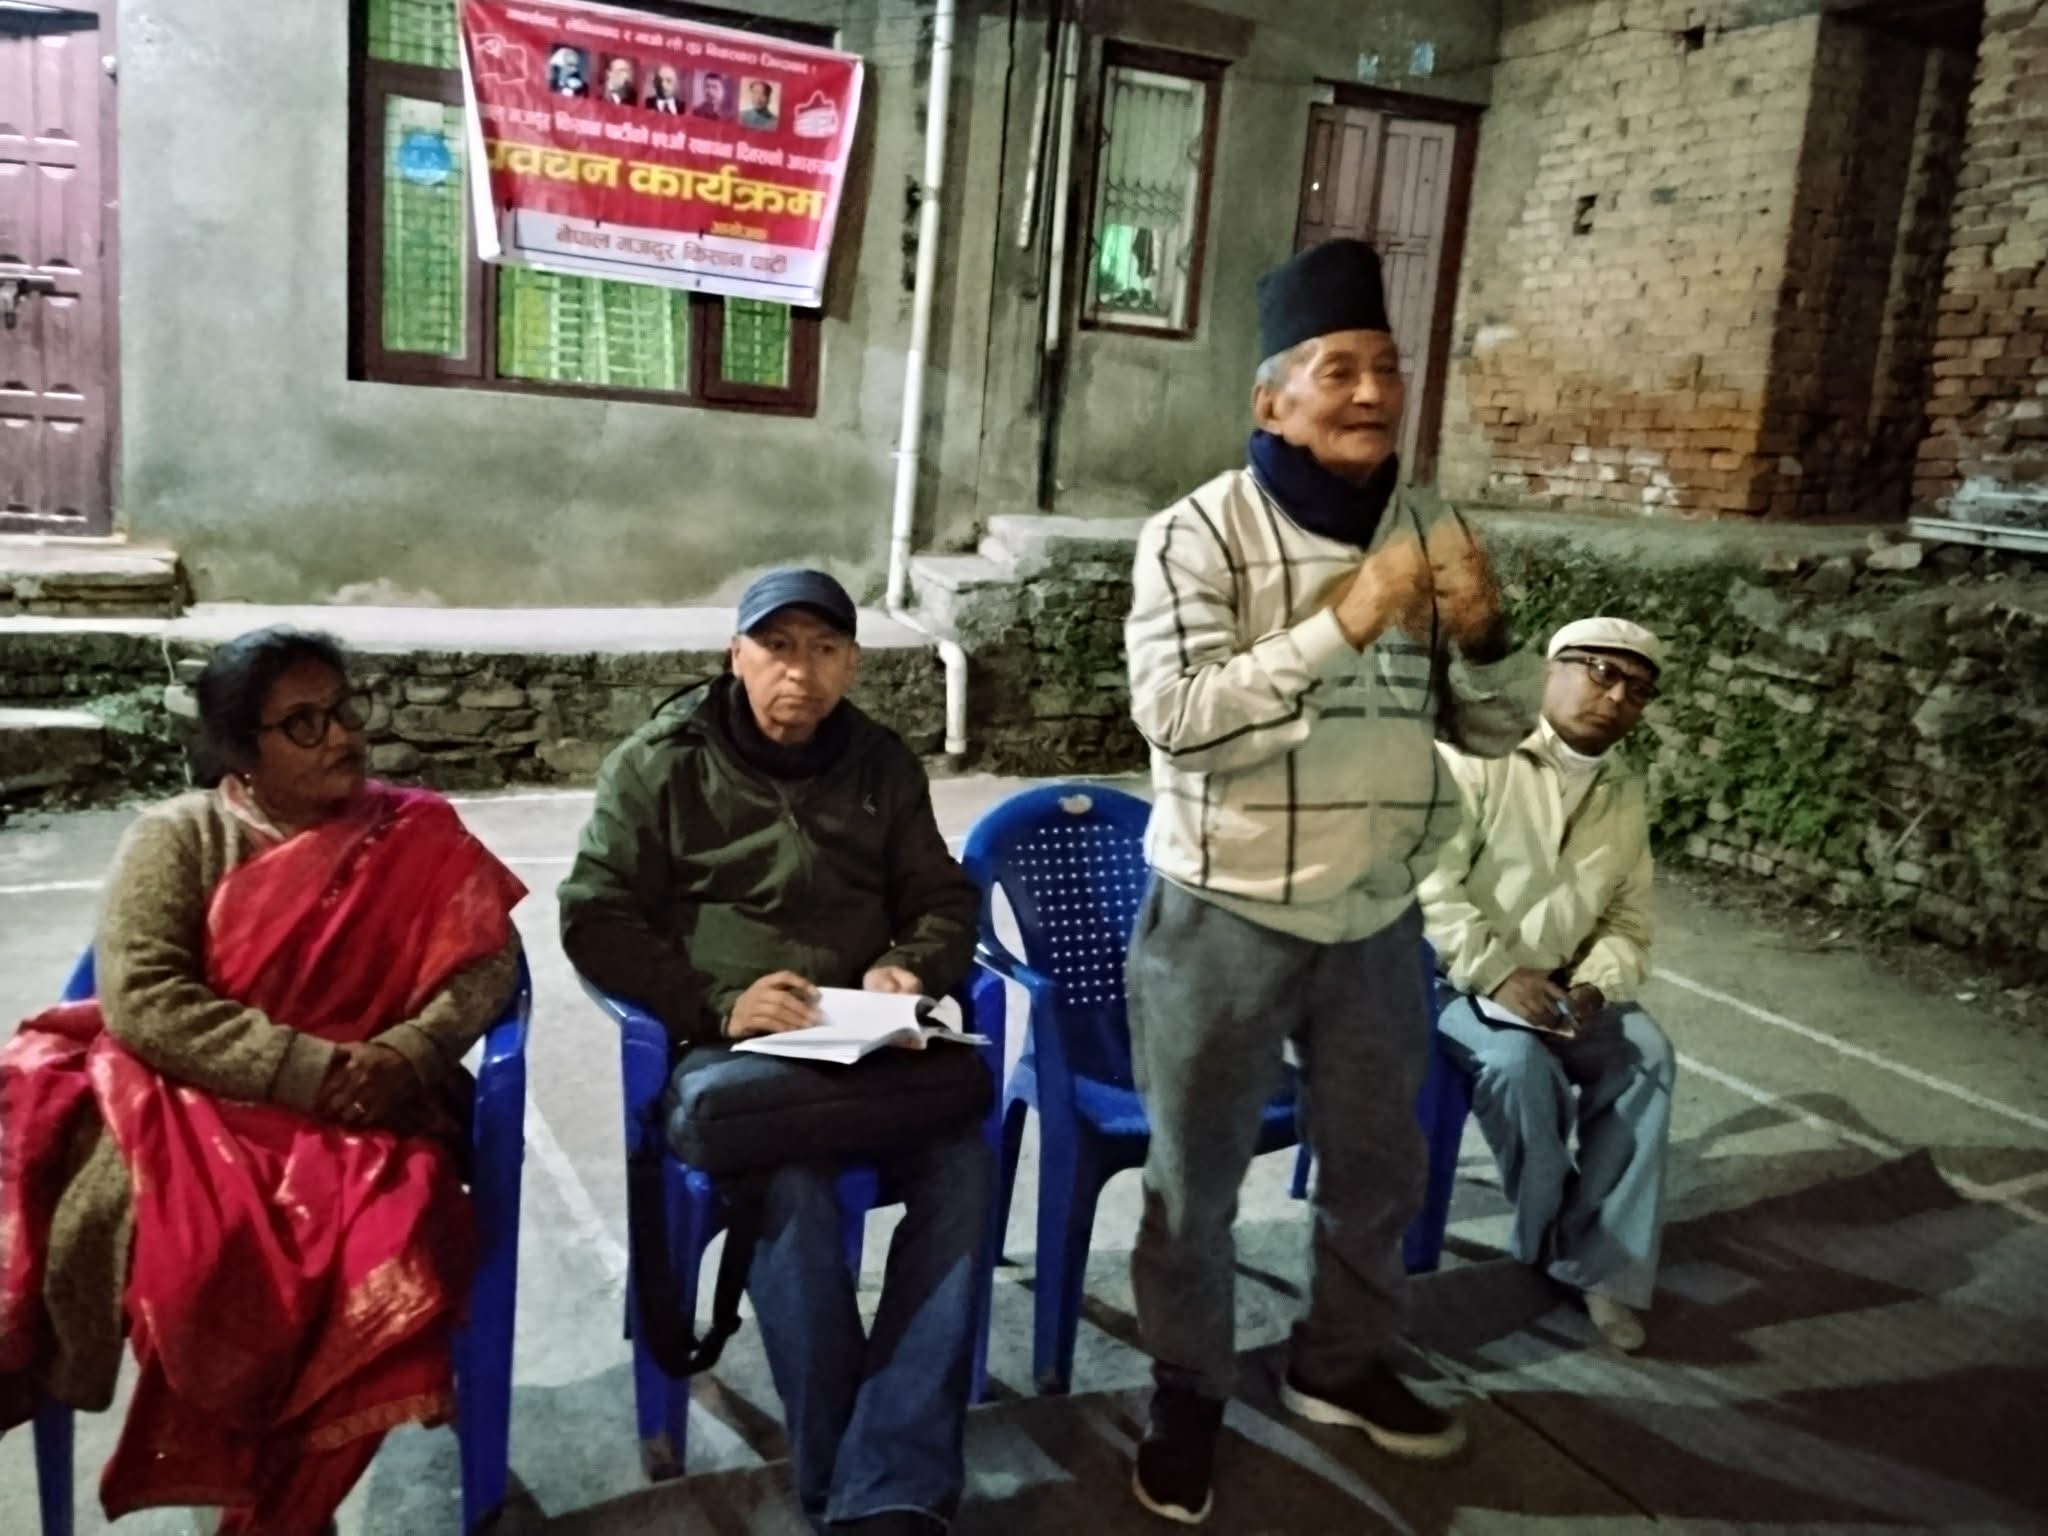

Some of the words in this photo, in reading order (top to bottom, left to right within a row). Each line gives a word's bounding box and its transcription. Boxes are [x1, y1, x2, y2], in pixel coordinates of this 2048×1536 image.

[628, 161, 825, 221] कार्यक्रम
[555, 225, 611, 249] नेपाल
[614, 236, 675, 262] मजदूर
[684, 244, 744, 267] किसान
